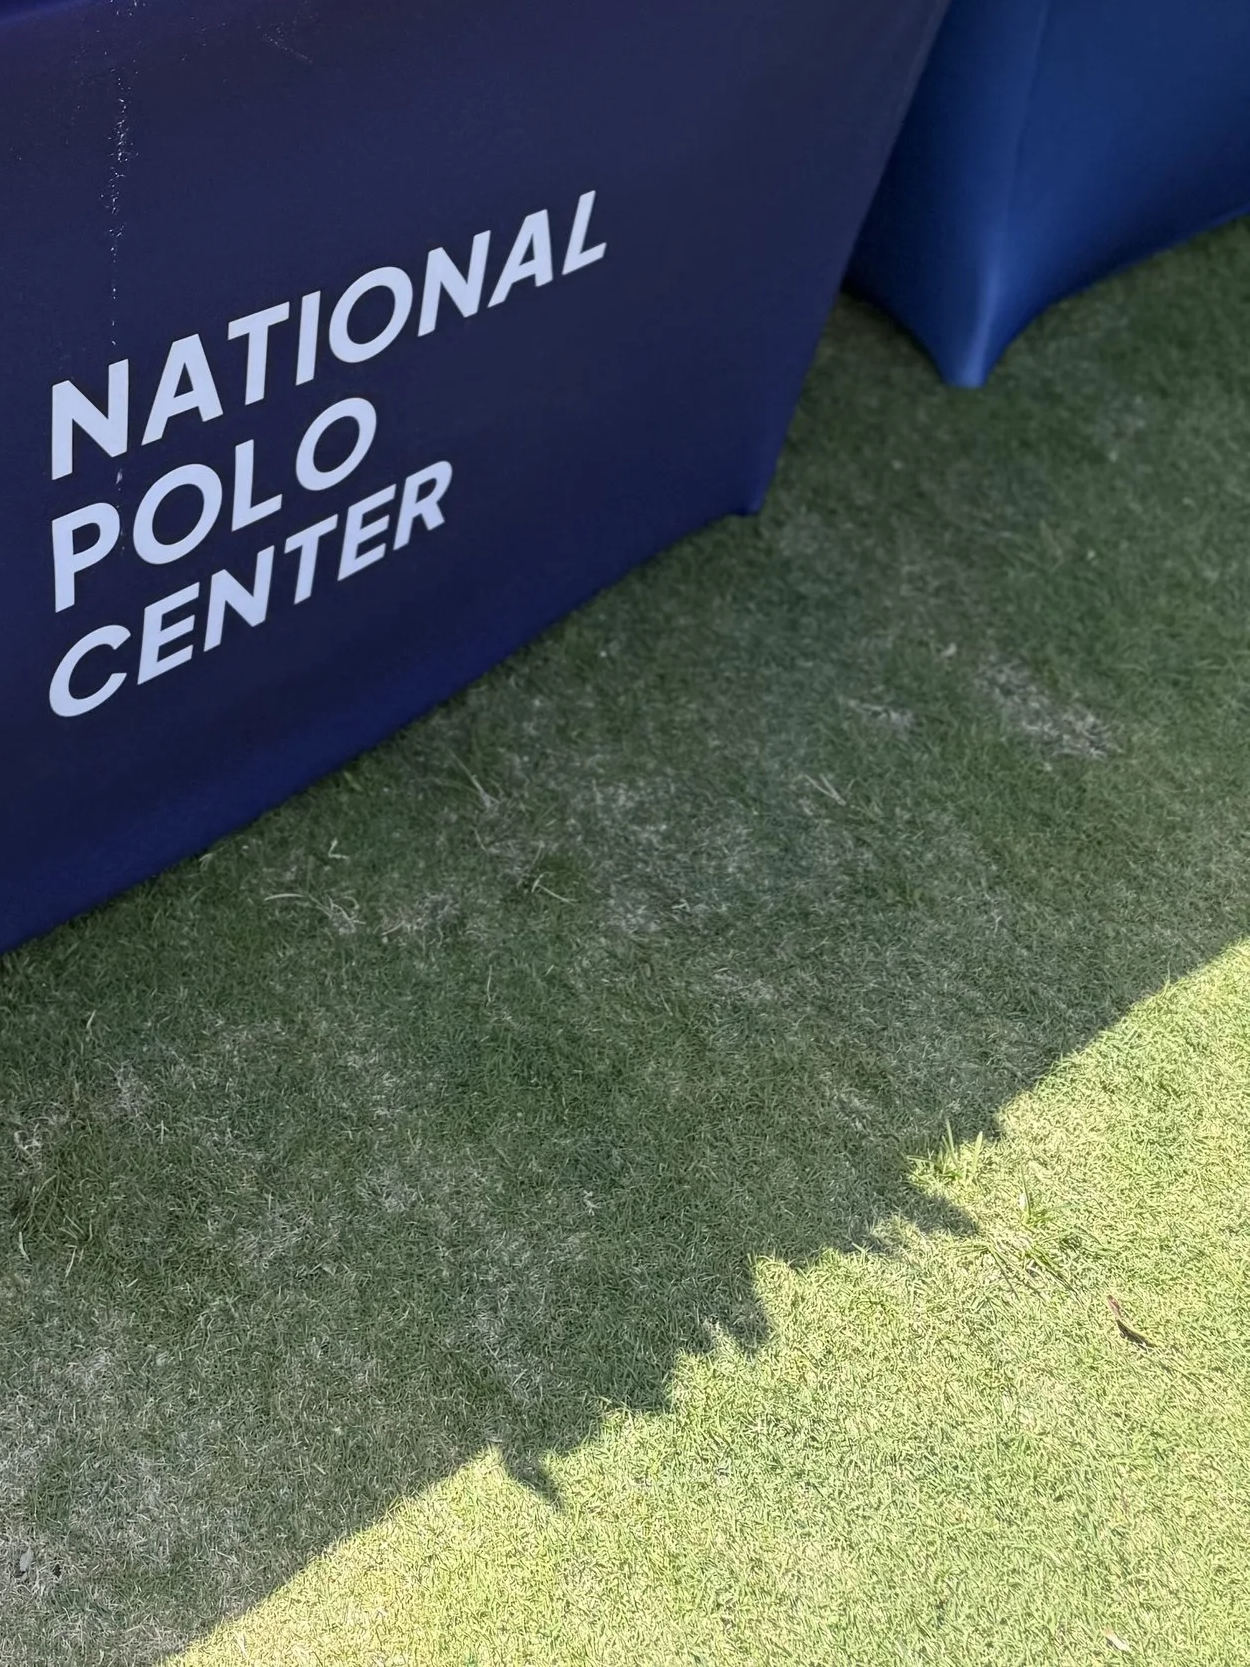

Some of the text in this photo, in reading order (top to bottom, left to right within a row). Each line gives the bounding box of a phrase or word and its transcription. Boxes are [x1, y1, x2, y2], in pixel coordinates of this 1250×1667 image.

[51, 190, 607, 480] NATIONAL
[49, 461, 452, 717] CENTER
[51, 397, 378, 613] POLO
